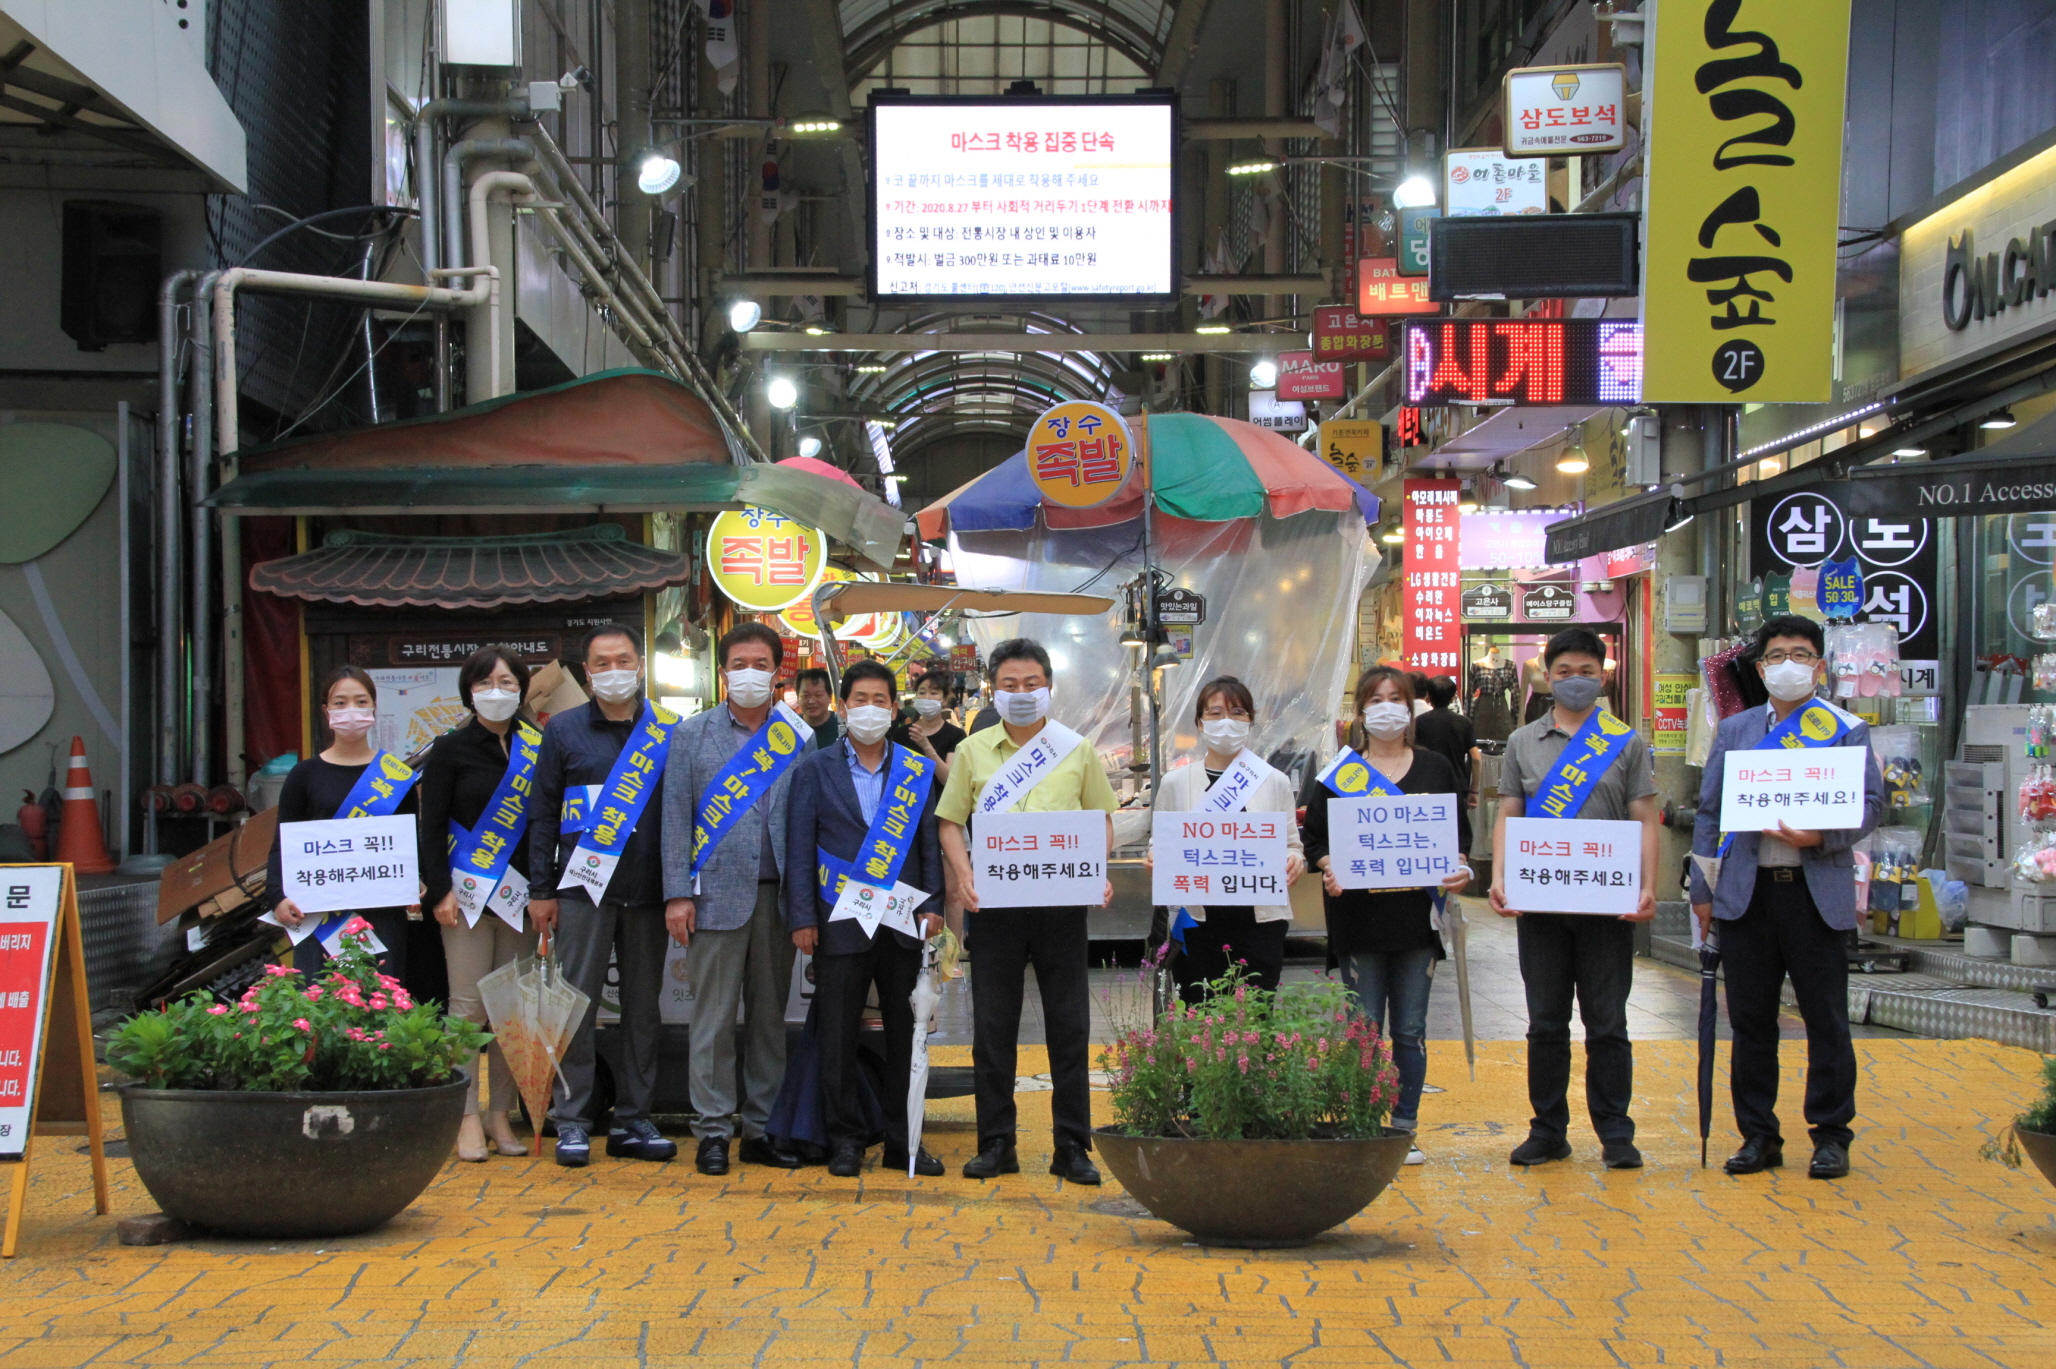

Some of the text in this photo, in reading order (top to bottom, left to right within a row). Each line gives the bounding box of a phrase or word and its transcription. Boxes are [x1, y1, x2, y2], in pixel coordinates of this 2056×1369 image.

[1519, 104, 1616, 129] 삼도보석
[951, 132, 1115, 152] 마스크 착용 집중 단속
[1521, 135, 1606, 145] 귀금속예물전문 563-7219
[894, 174, 1099, 188] 코 끝까지 마스크를 제대로 착용해 주세요
[1472, 163, 1541, 183] 어촌마을
[1495, 188, 1513, 203] 2F
[894, 199, 1172, 213] 기간: 2020.8.27 부터 사회적 거리두기 1단계 전환 시까지
[894, 226, 1096, 240] 장소 및 대상: 전통시장 내 상인 및 이용자
[894, 253, 1097, 266] 적발시: 벌금 300만원 또는 과태료 10만원
[890, 281, 921, 294] 신고처:
[1369, 282, 1429, 302] 배트맨
[1320, 334, 1384, 350] 종합화장품
[1430, 324, 1563, 400] 시계
[1723, 350, 1756, 380] 2F
[1292, 385, 1330, 394] 여성브랜드
[1048, 413, 1102, 438] 장수
[1253, 416, 1303, 427] 어썸플레이
[1035, 433, 1122, 487] 족발
[1412, 490, 1457, 505] 아모레퍼시픽
[1918, 482, 1971, 506] NO.1
[1416, 508, 1443, 523] 마몽드
[1416, 526, 1452, 541] 아이오페
[721, 535, 810, 586] 족발
[1825, 575, 1855, 590] SALE
[1161, 602, 1197, 611] 맛있는과일
[1416, 608, 1452, 622] 이자녹스
[566, 618, 585, 626] 경기도
[402, 641, 548, 659] 구리전통시장 안내도
[1805, 710, 1831, 736] 코로나19
[771, 726, 792, 750] 코로나19
[1045, 743, 1058, 758] 구리시
[1006, 747, 1047, 788] 마스크
[1245, 766, 1259, 779] 구리시
[1738, 767, 1835, 783] 마스크 꼭!!
[593, 751, 655, 846] 마스크 착용
[1213, 771, 1249, 812] 마스크
[1540, 764, 1588, 818] 마스크
[1737, 790, 1856, 807] 착용해주세요!
[702, 774, 750, 829] 마스크
[470, 774, 533, 869] 마스크 착용
[1357, 805, 1447, 824] NO 마스크
[865, 785, 917, 879] 마스크 착용
[1182, 821, 1277, 841] NO 마스크
[1358, 832, 1437, 850] 턱스크는,
[304, 835, 394, 857] 마스크 꼭!!
[986, 832, 1079, 853] 마스크 꼭!!
[1520, 839, 1613, 858] 마스크 꼭!!
[1183, 847, 1265, 868] 턱스크는,
[1350, 856, 1456, 877] 폭력 입니다.
[296, 863, 405, 887] 착용해주세요!!
[580, 866, 598, 878] 구리시
[987, 862, 1101, 882] 착용해주세요!
[1519, 866, 1633, 887] 착용해주세요!
[1173, 874, 1284, 895] 폭력 입니다.
[6, 886, 31, 908] 문
[8, 991, 30, 1008] 배출
